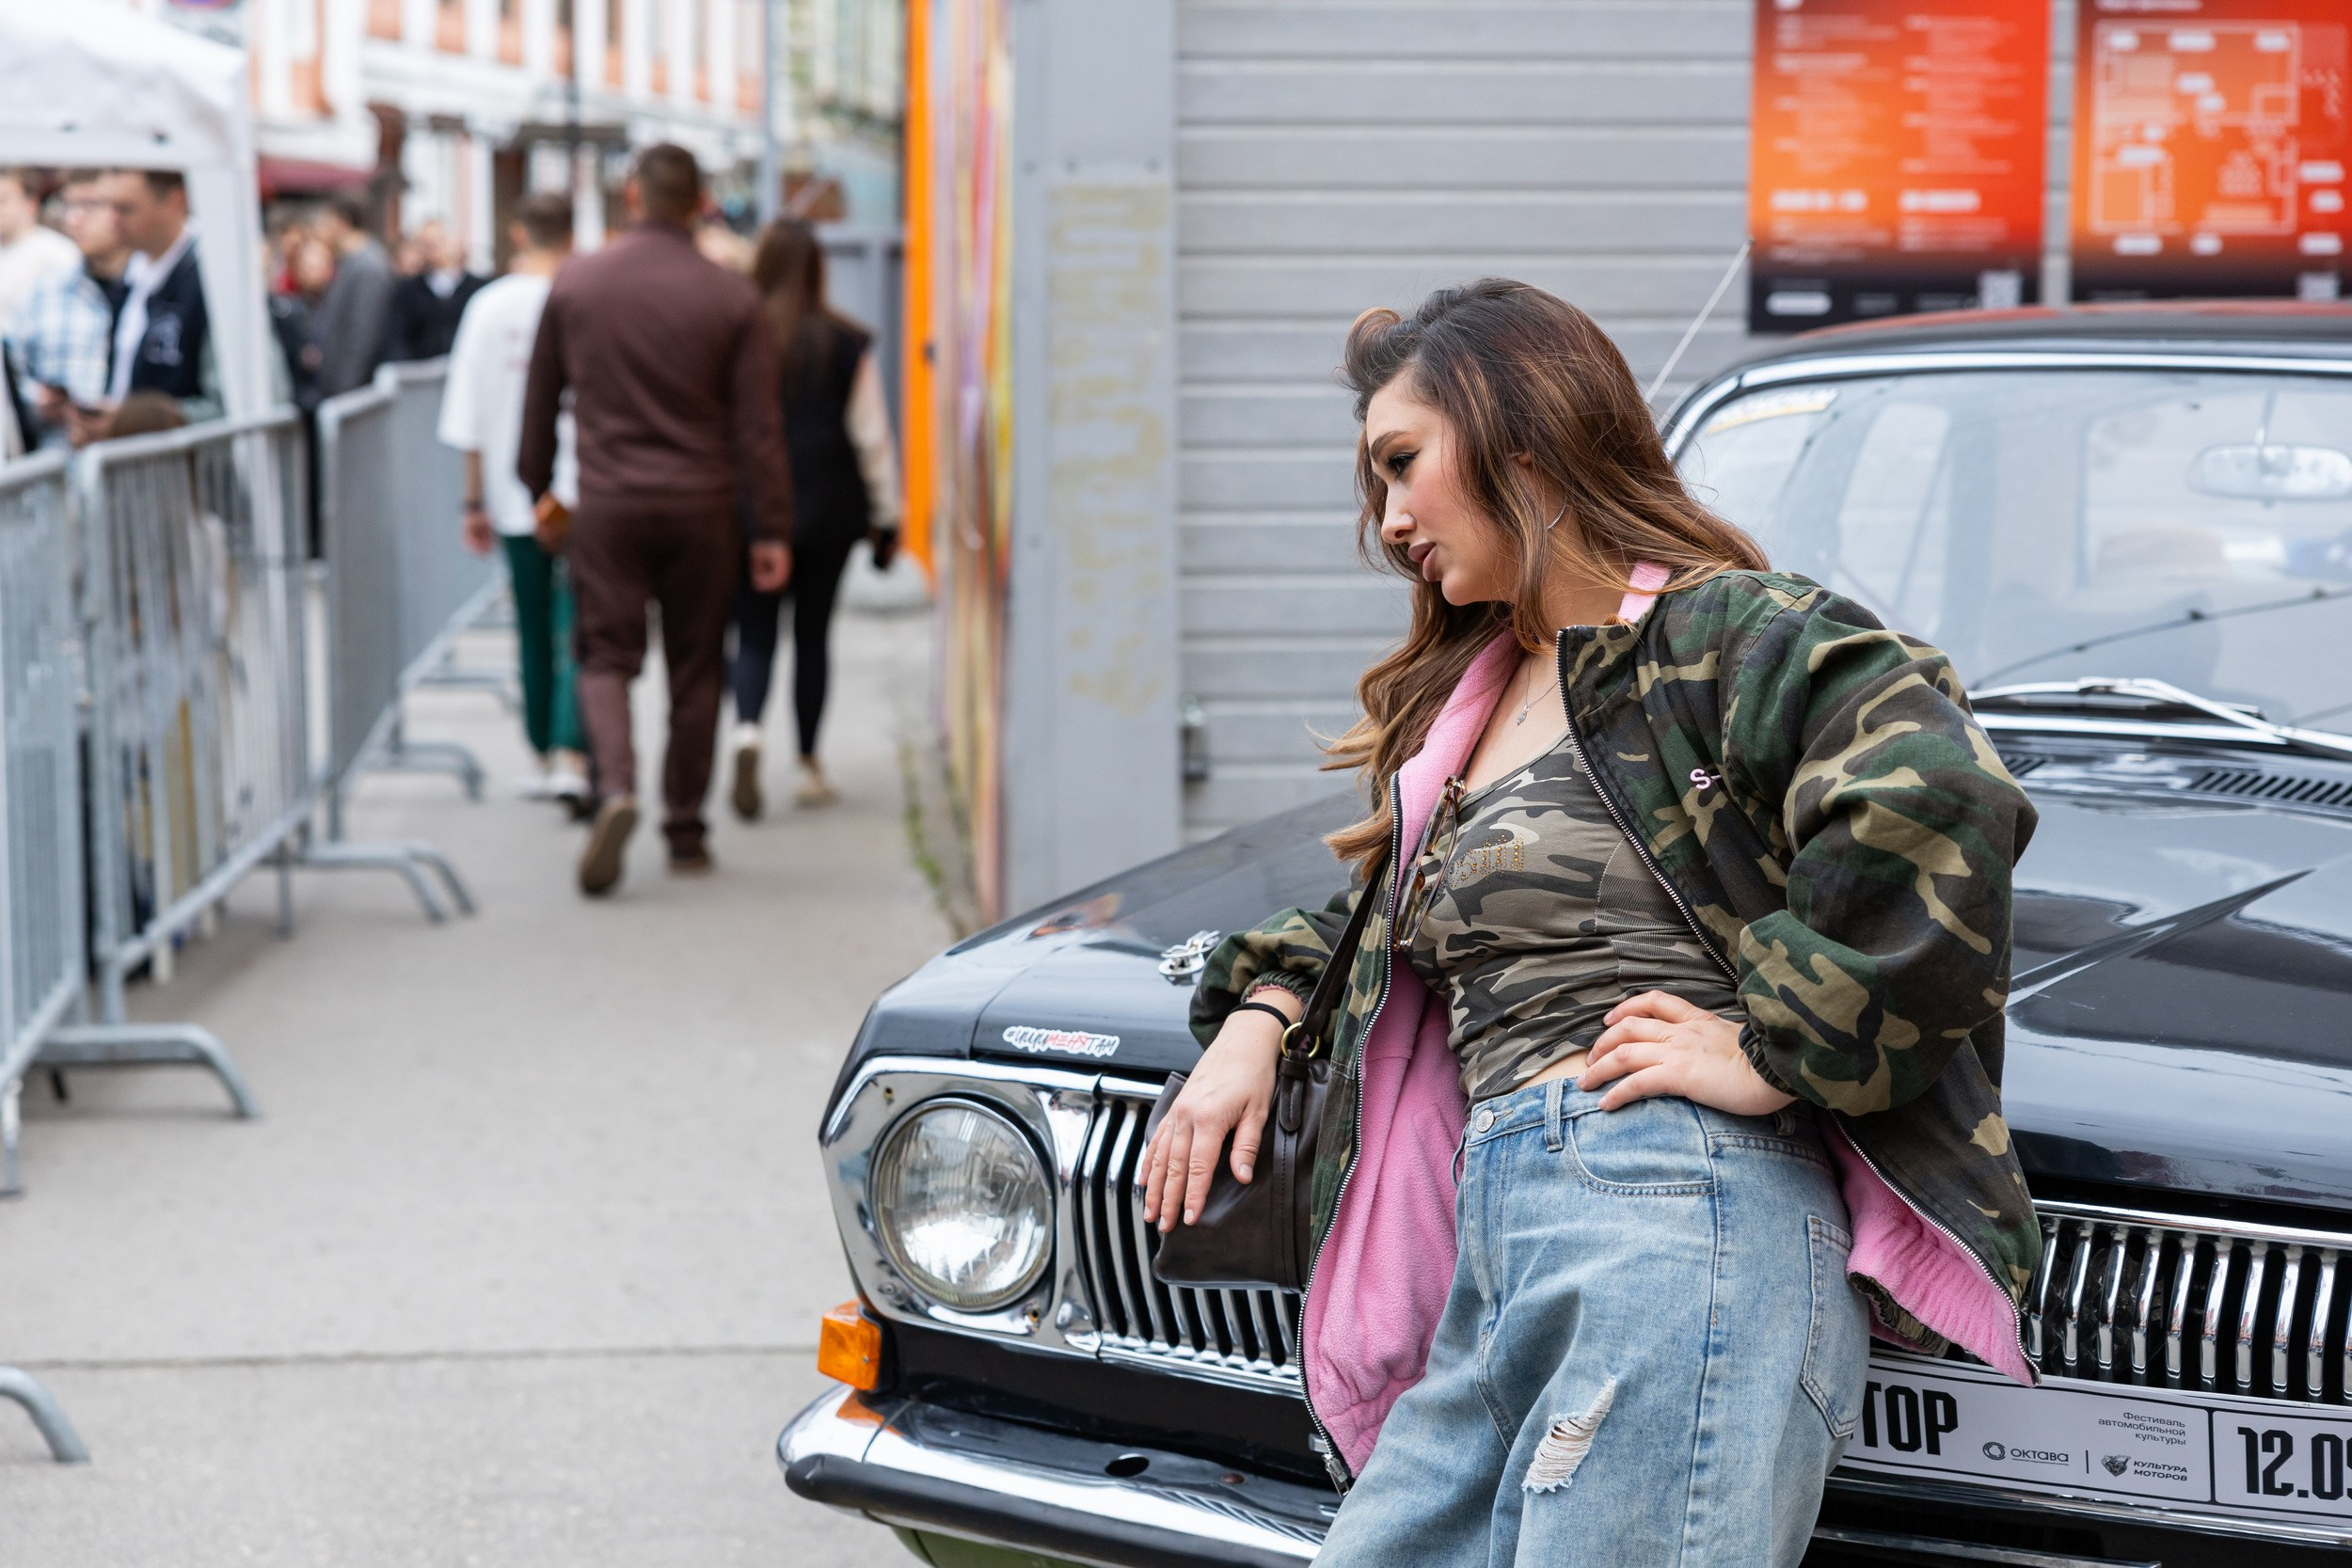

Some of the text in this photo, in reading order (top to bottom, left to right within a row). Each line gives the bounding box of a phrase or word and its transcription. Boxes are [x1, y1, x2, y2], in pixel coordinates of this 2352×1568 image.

[1850, 1380, 1959, 1456] ТОР
[2122, 1412, 2185, 1428] Фестиваль
[2098, 1418, 2185, 1436] автомобильной
[2135, 1433, 2186, 1446] культуры
[2133, 1460, 2187, 1473] КУЛЬТУРА
[2237, 1426, 2352, 1501] 12.0
[2134, 1469, 2188, 1481] МОТОРОВ
